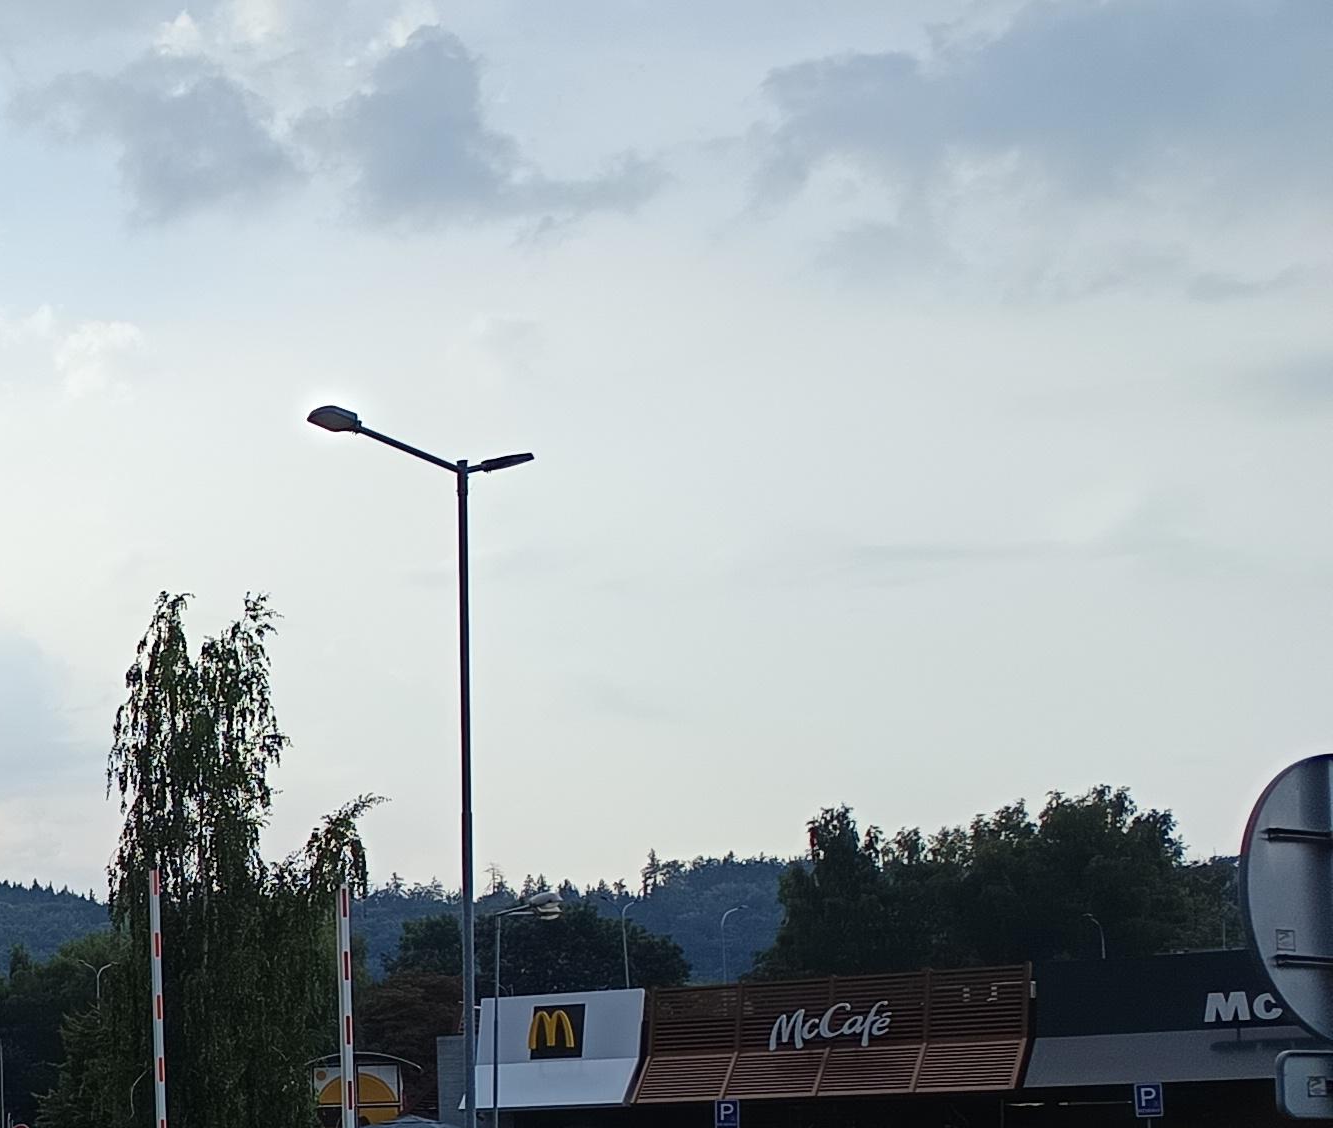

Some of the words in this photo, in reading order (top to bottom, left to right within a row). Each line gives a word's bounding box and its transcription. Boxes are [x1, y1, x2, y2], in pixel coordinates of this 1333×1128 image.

[769, 1000, 893, 1052] McCafé
[1140, 1087, 1156, 1107] P
[719, 1103, 734, 1121] P
